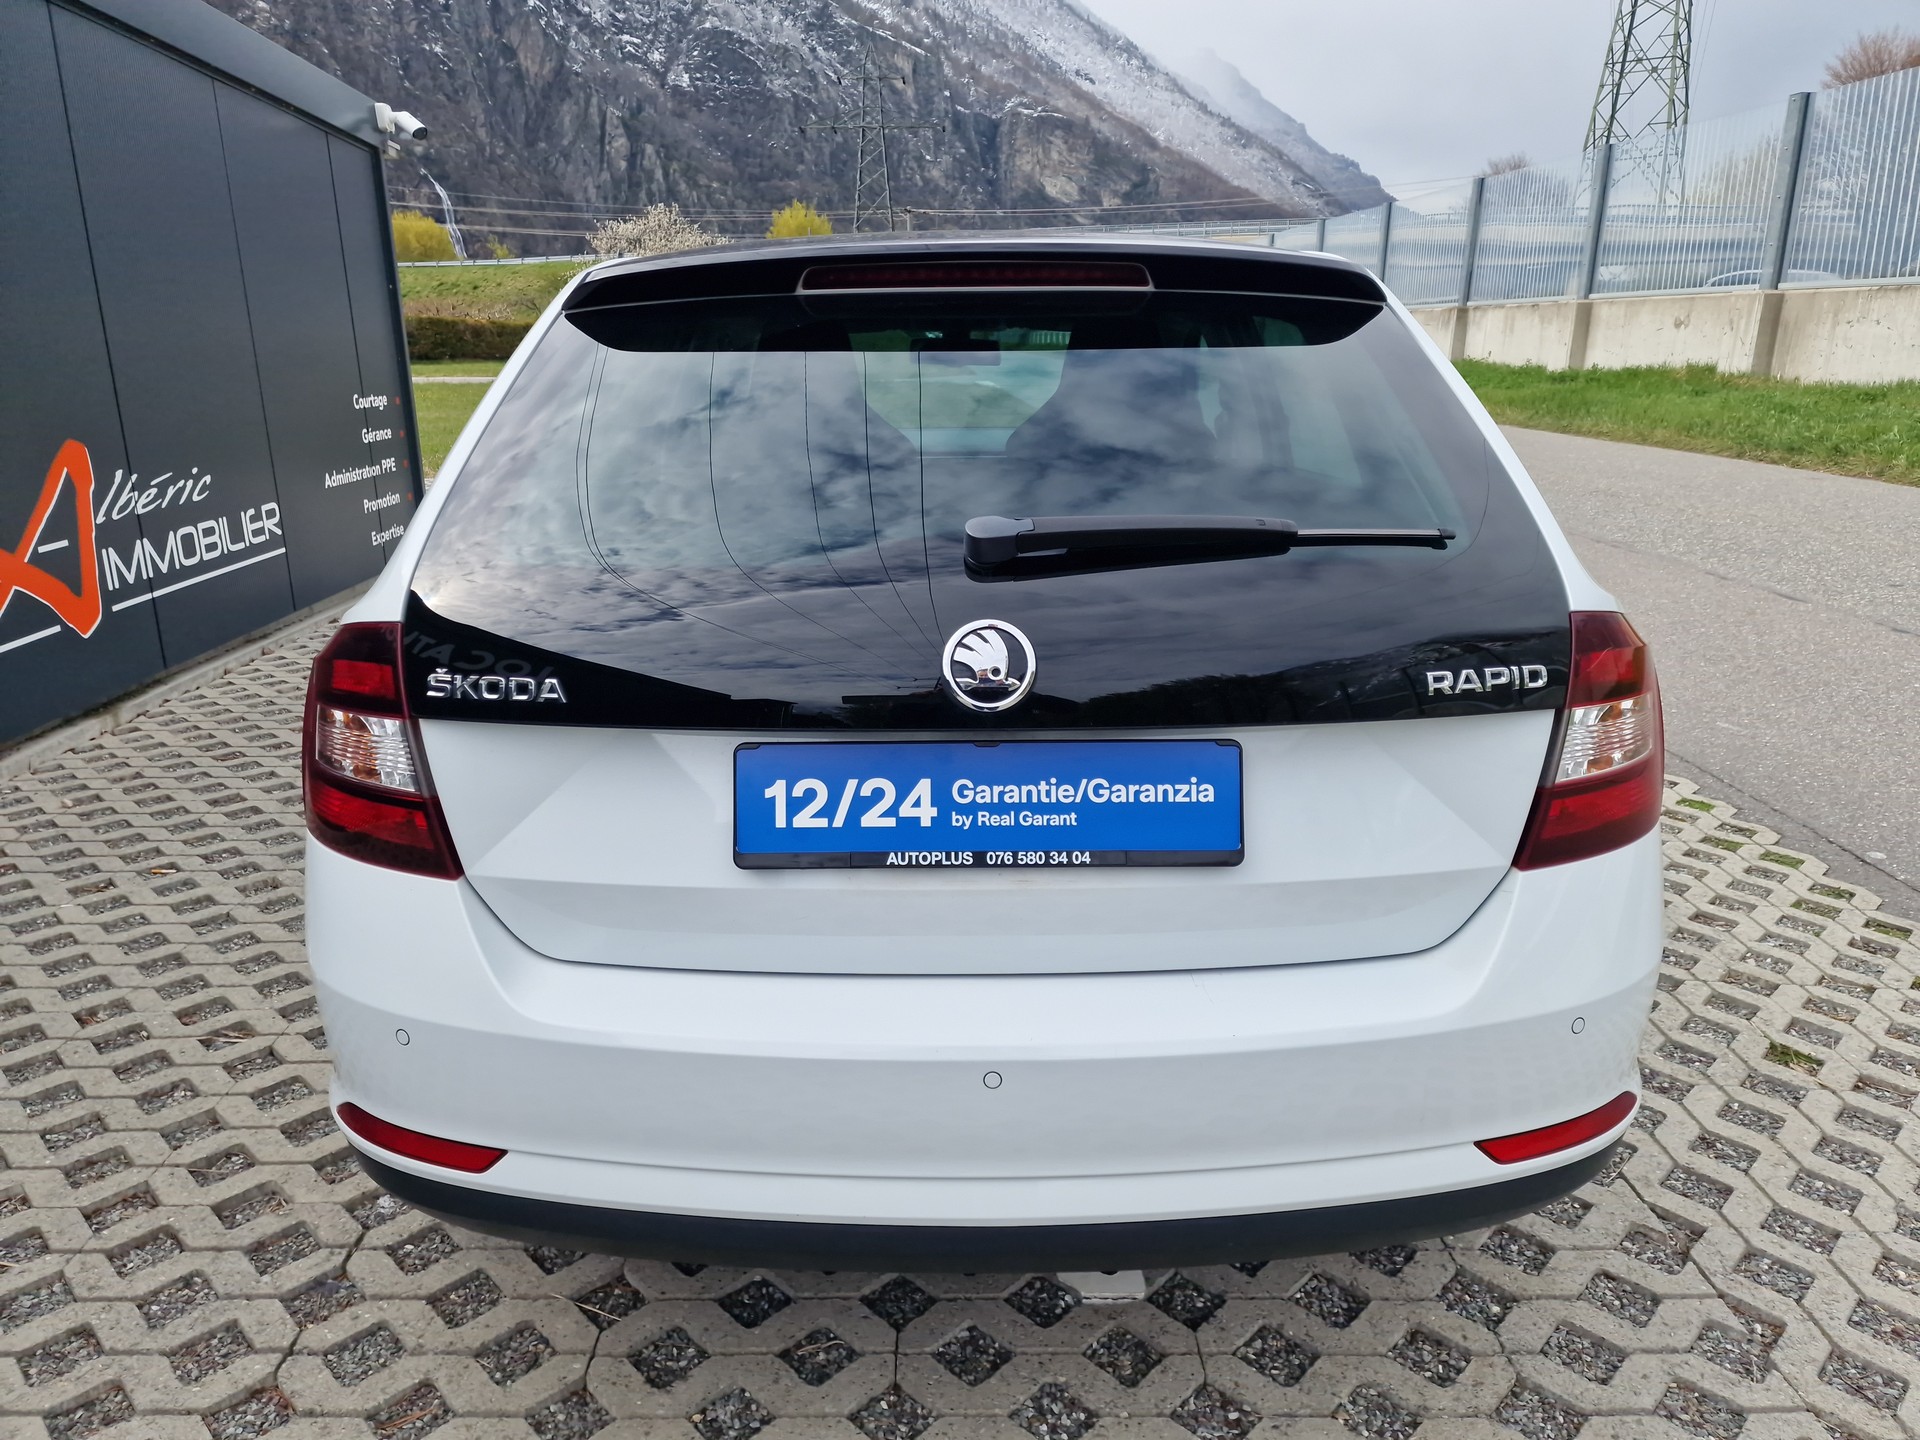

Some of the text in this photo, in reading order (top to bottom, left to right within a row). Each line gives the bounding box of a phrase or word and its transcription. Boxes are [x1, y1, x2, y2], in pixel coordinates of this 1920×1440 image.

[353, 393, 388, 411] Courtage
[361, 427, 392, 444] Gérance
[324, 457, 396, 489] Administration PPE
[363, 492, 401, 514] Promotion
[101, 501, 283, 591] IMMOBILIER
[371, 524, 405, 547] Expertise
[426, 667, 567, 704] ŠKODA
[1425, 664, 1548, 696] RAPID
[764, 777, 938, 829] 12/24
[951, 776, 1216, 805] Garantie/Garanzia
[951, 811, 1078, 830] by Real Garant
[886, 851, 1091, 866] AUTOPLUS 076 580 34 04
